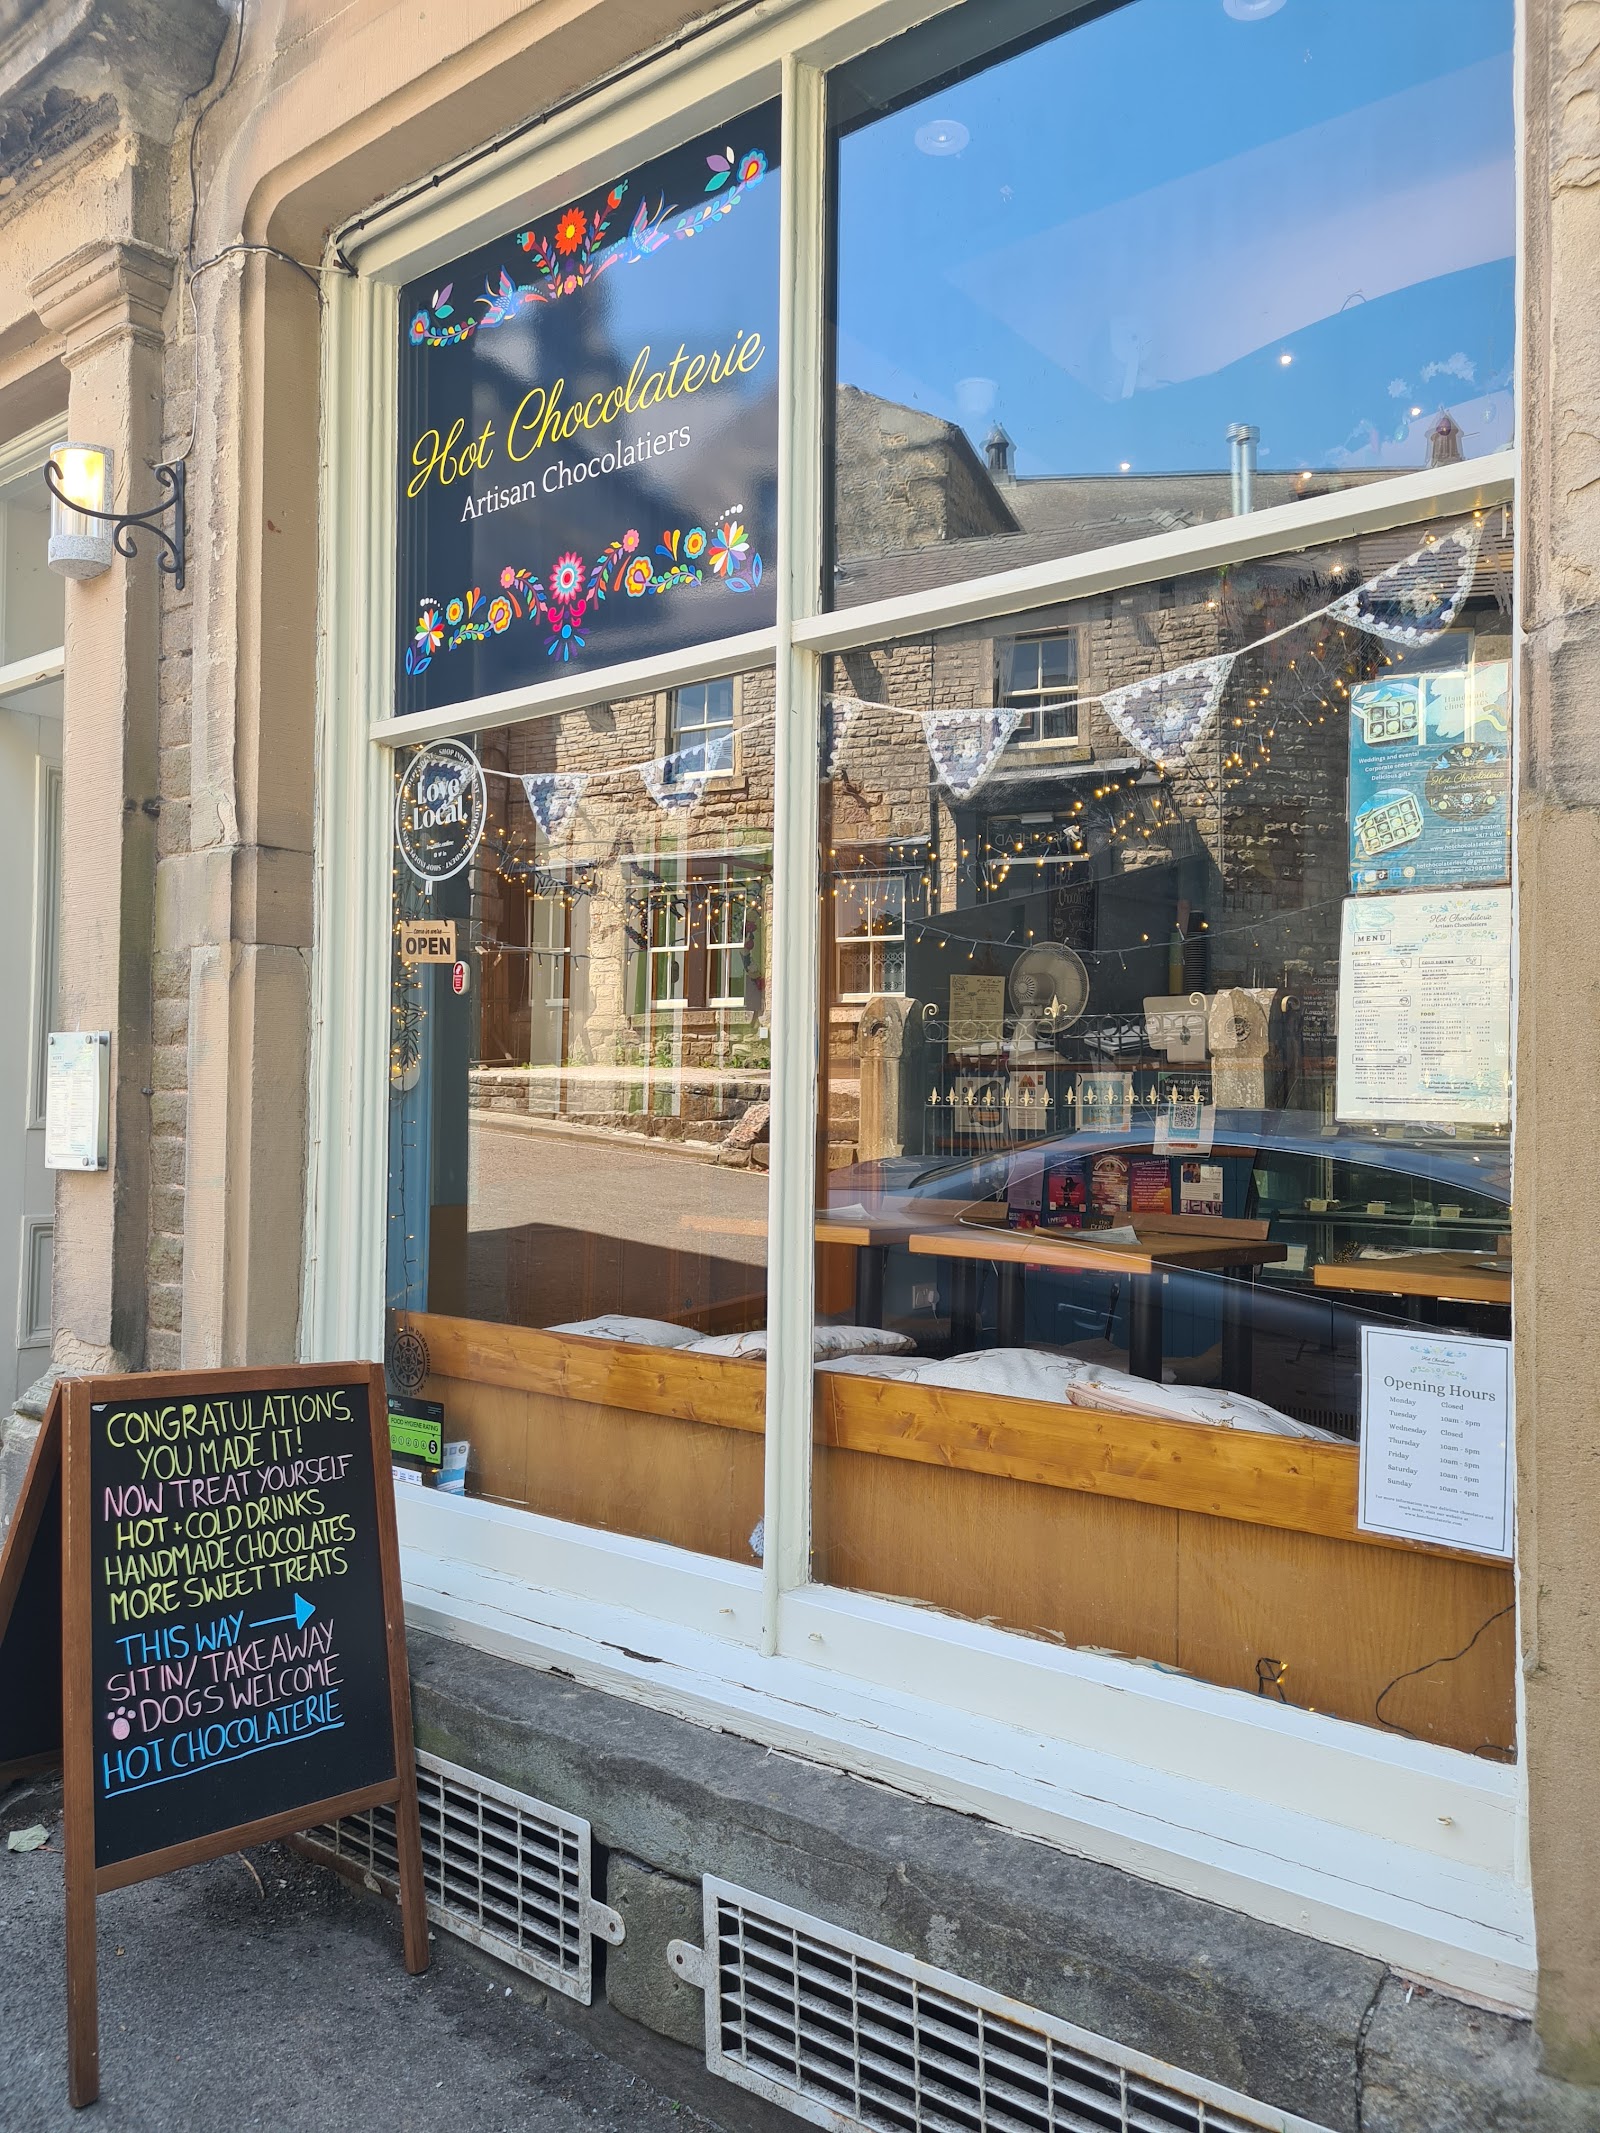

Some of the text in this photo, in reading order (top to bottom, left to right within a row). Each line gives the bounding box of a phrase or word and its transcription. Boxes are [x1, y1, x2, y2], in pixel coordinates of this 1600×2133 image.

[407, 328, 766, 499] Hot Chocolaterie
[460, 424, 692, 524] Artisan Chocolatiers
[417, 777, 460, 805] Love
[414, 795, 468, 830] Local.
[406, 938, 450, 955] OPEN
[1384, 1376, 1496, 1401] Opening Hours
[1390, 1397, 1416, 1406] Monday
[1389, 1410, 1417, 1420] Tuesday
[1441, 1402, 1464, 1410] Closed
[404, 1420, 422, 1428] HYGIENE
[1389, 1424, 1427, 1435] Wednesday
[1441, 1430, 1463, 1438] Closed
[137, 1426, 303, 1480] YOU MADE IT!
[430, 1442, 436, 1453] 5
[1388, 1437, 1420, 1448] Thursday
[1388, 1451, 1410, 1460] Friday
[1388, 1464, 1418, 1475] Saturday
[104, 1454, 353, 1521] NOW TREAT YOURSELF
[1388, 1478, 1412, 1488] Sunday
[117, 1517, 168, 1550] HOT
[185, 1505, 242, 1539] COLD
[247, 1489, 325, 1530] DRINKS
[105, 1514, 356, 1586] HANDMADE CHOCOLATES
[110, 1547, 348, 1624] MORE SWEET TREATS
[115, 1610, 244, 1665] THIS WAY
[107, 1666, 155, 1701] SIT
[140, 1654, 344, 1733] DOGS WELCOME
[103, 1689, 344, 1789] HOT CHOCOLATERIE
